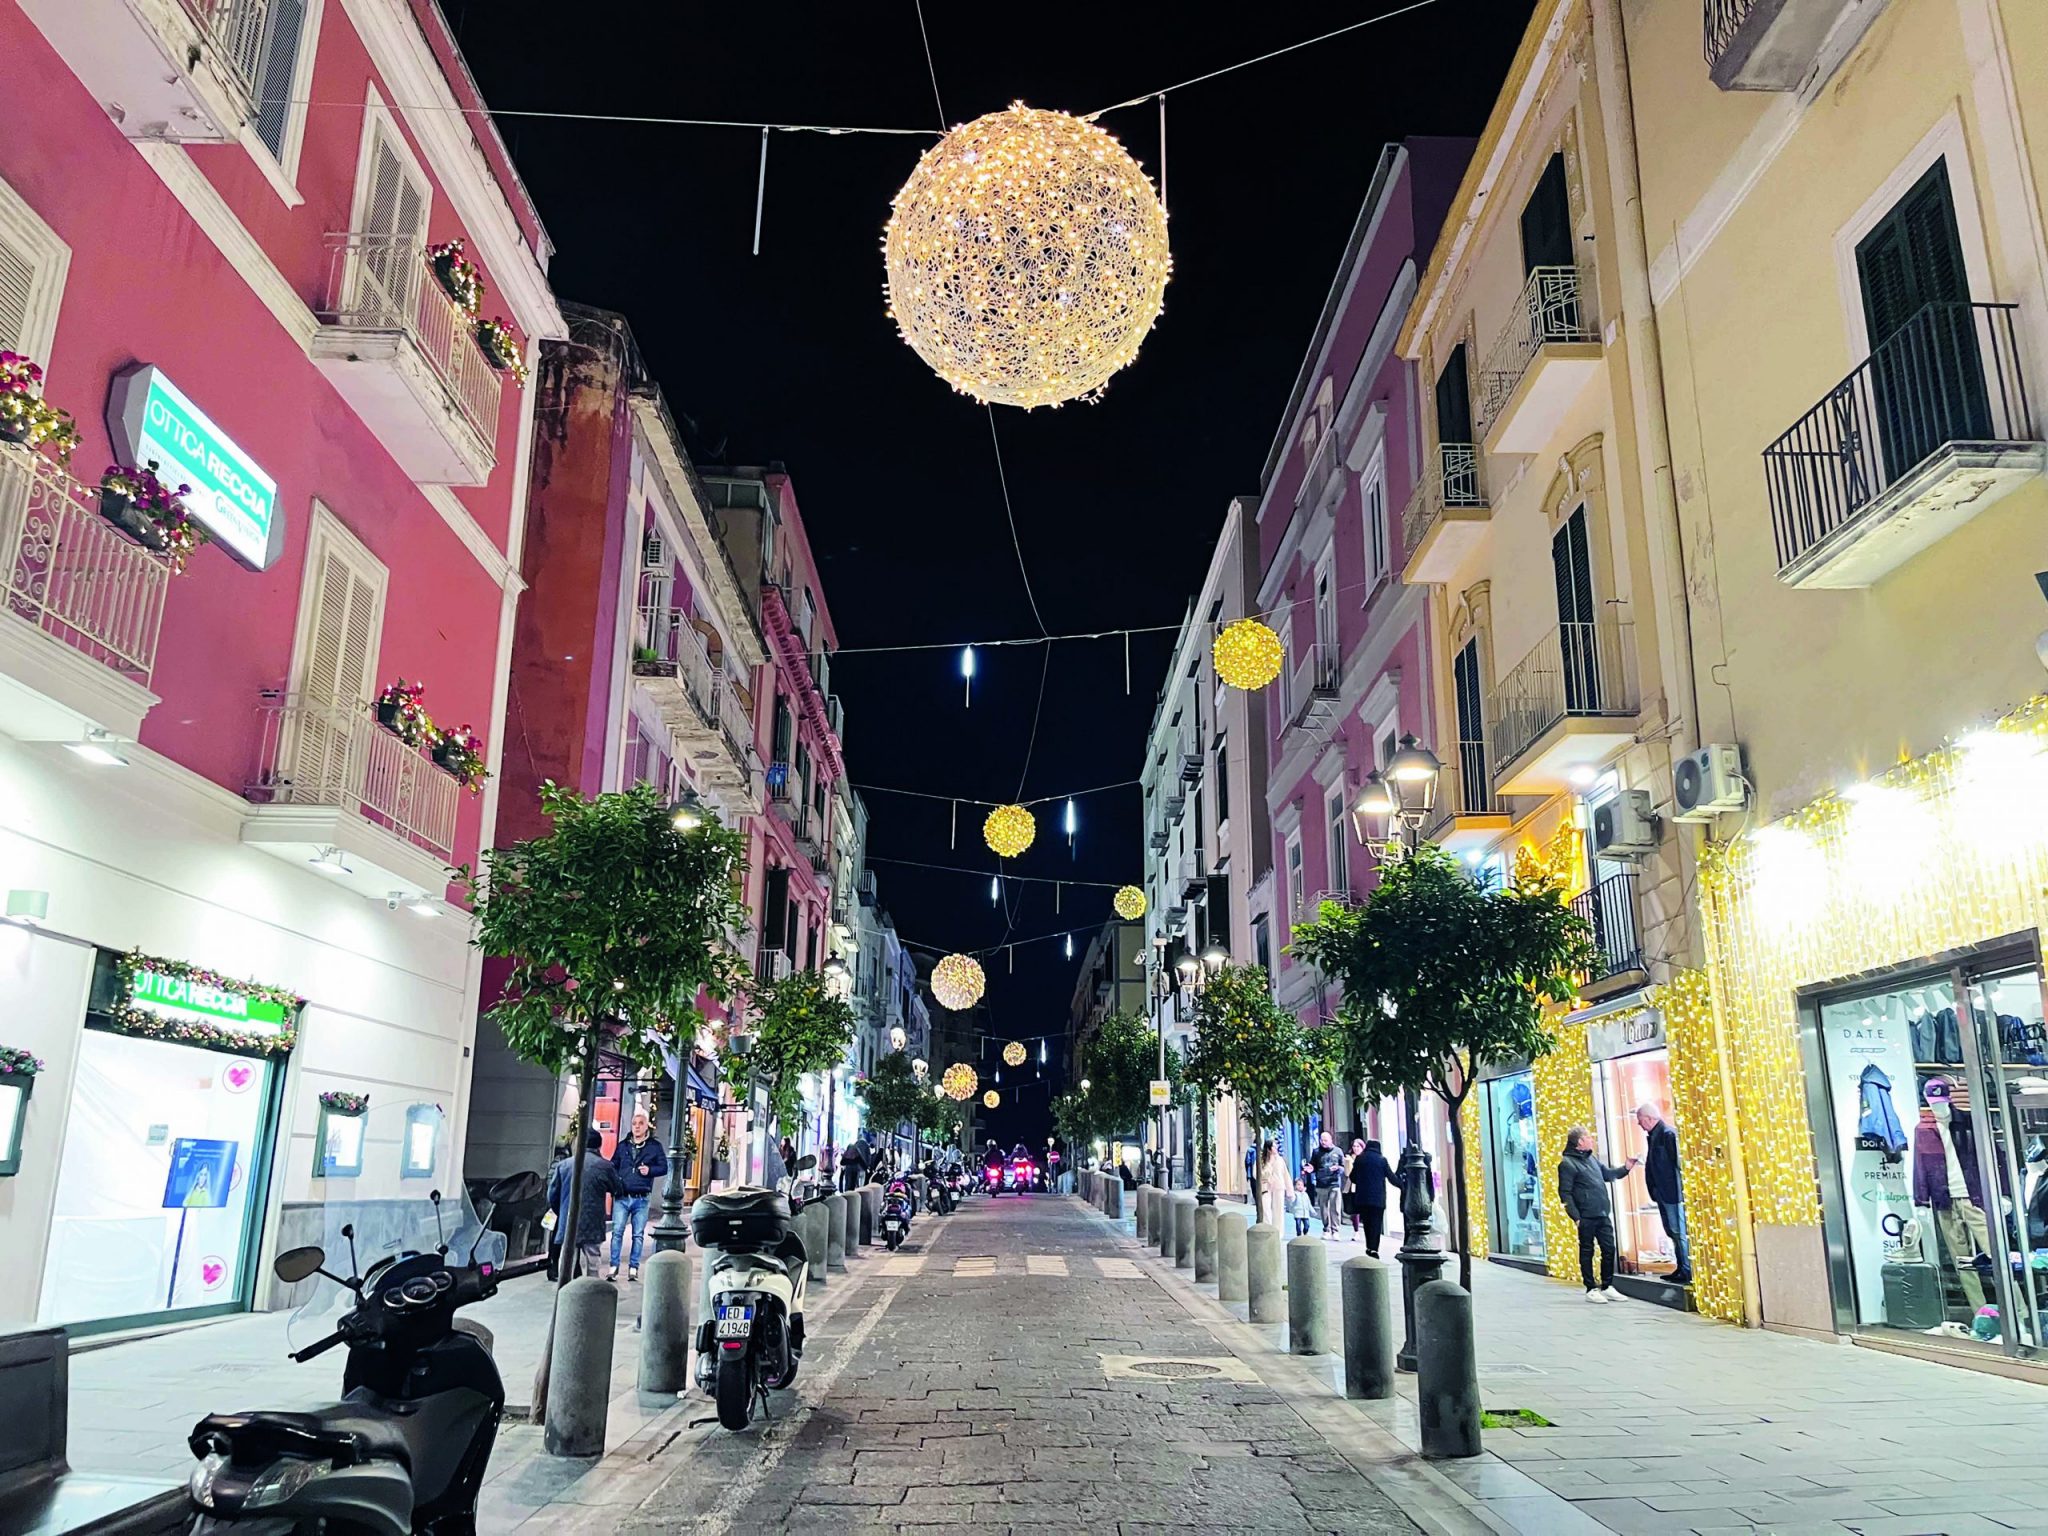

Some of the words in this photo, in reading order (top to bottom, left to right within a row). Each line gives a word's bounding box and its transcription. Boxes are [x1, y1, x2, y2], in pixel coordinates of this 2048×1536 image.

[150, 400, 206, 466] OTTICA
[207, 451, 267, 522] RECCIA
[1864, 1171, 1907, 1180] PREMIATA
[719, 1322, 749, 1334] 41948
